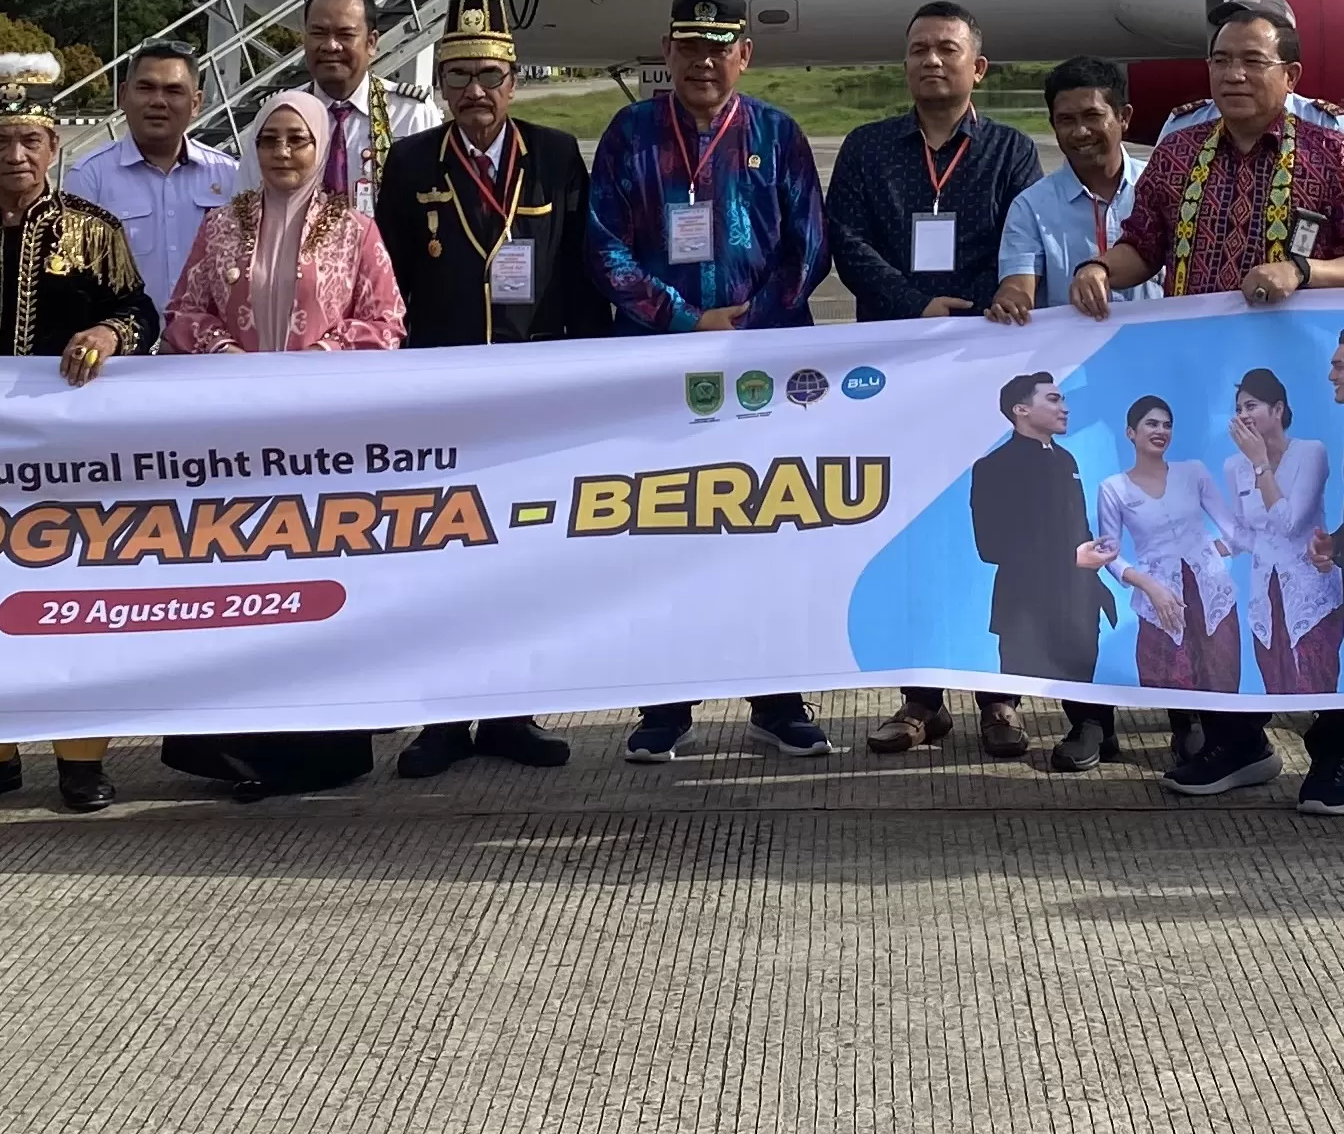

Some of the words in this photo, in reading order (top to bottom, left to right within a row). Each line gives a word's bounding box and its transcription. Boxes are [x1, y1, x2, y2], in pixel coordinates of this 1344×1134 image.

[847, 376, 880, 389] BLU
[132, 448, 252, 488] Flight
[261, 445, 355, 477] Rute
[364, 442, 459, 474] Baru
[567, 456, 891, 539] BERAU
[38, 600, 80, 625] 29
[85, 597, 215, 630] Agustus
[222, 590, 302, 619] 2024
